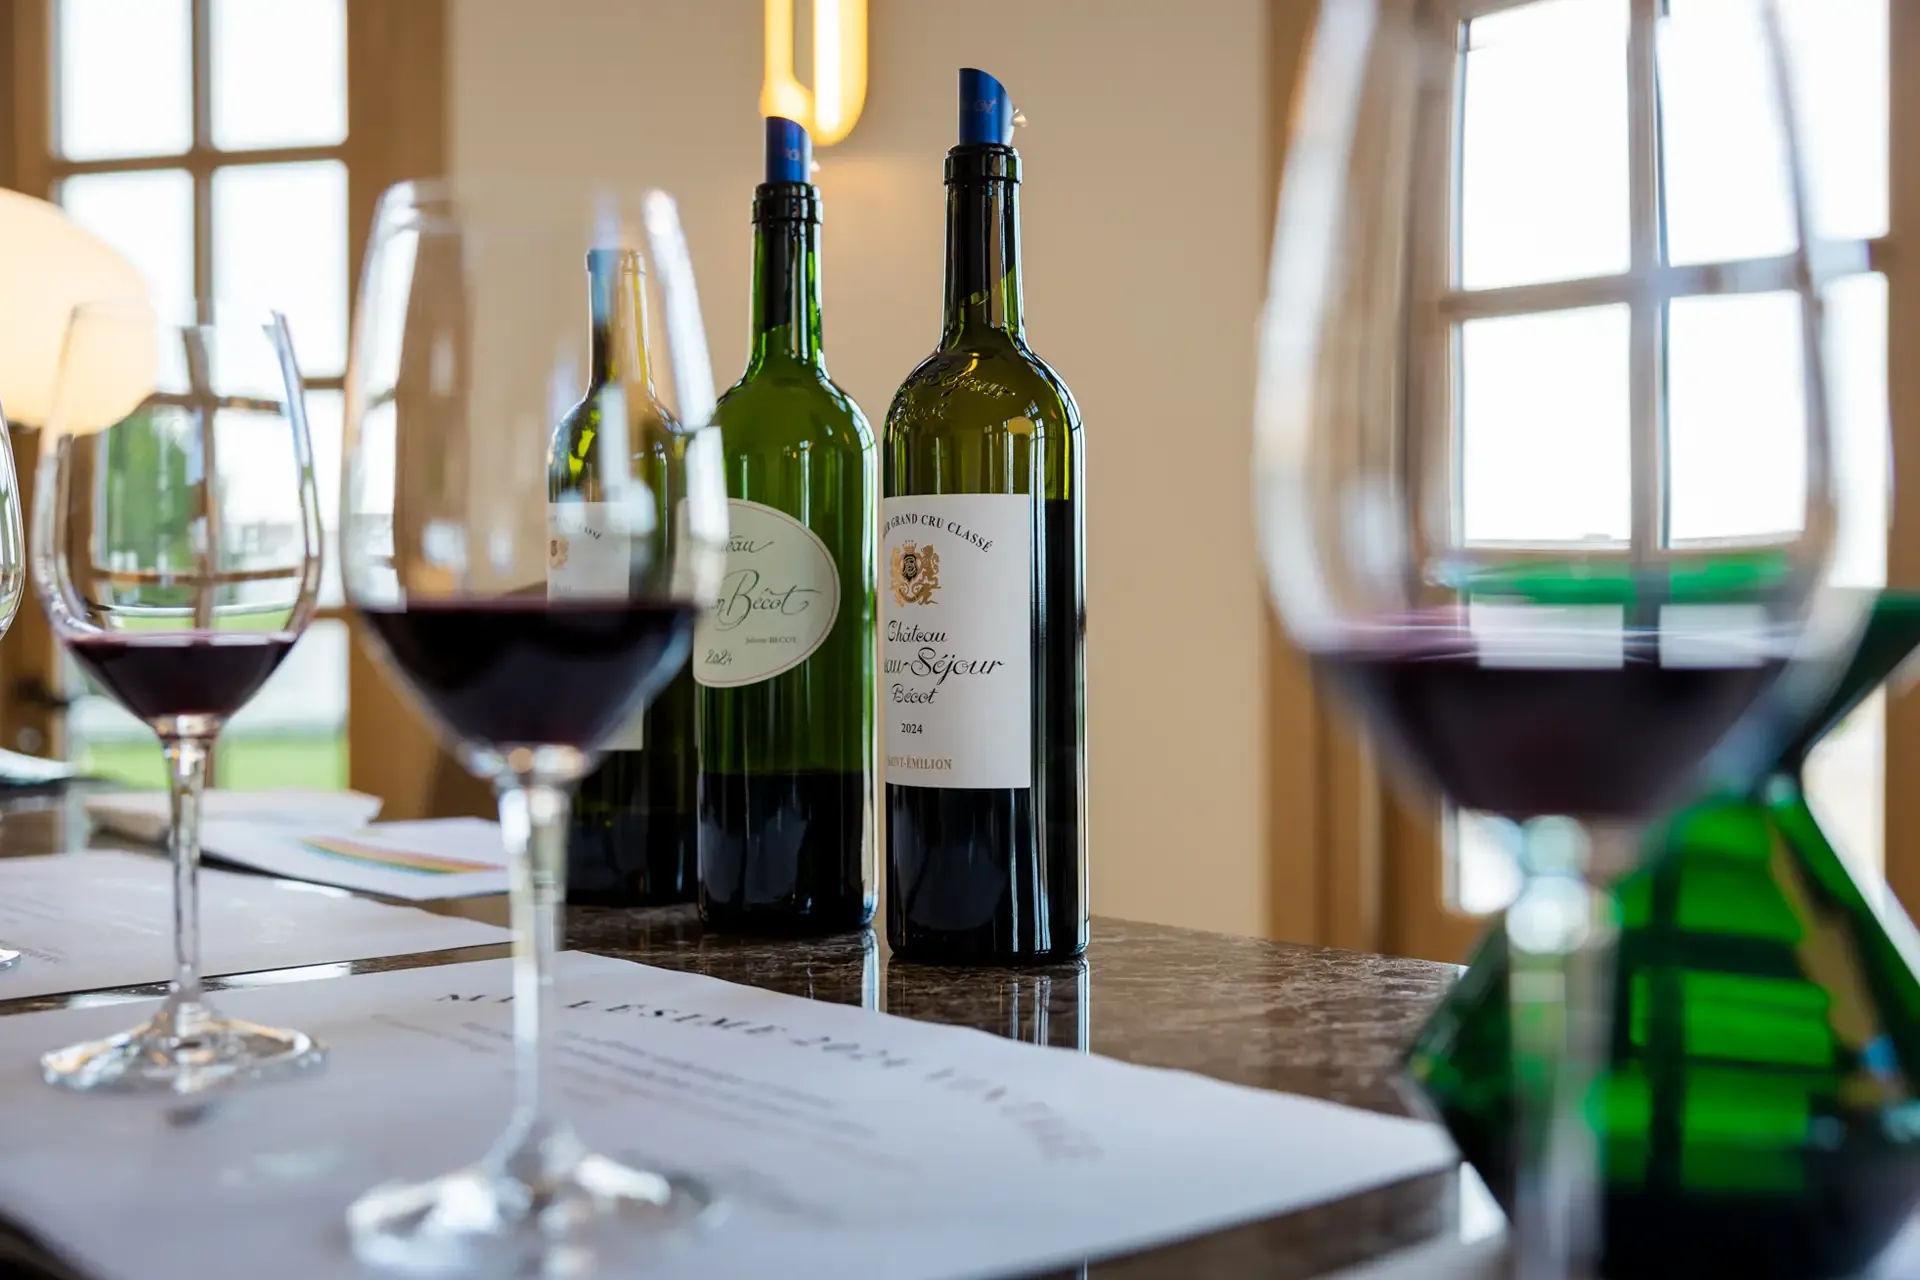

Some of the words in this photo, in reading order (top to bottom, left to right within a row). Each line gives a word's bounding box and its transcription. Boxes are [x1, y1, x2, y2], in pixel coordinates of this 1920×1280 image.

[891, 513, 918, 528] GRAND
[921, 514, 945, 529] CRU
[947, 521, 994, 553] CLASSÉ
[715, 568, 822, 632] Bécot
[887, 620, 948, 643] Château
[891, 683, 938, 704] Bécot
[901, 722, 923, 734] 2024
